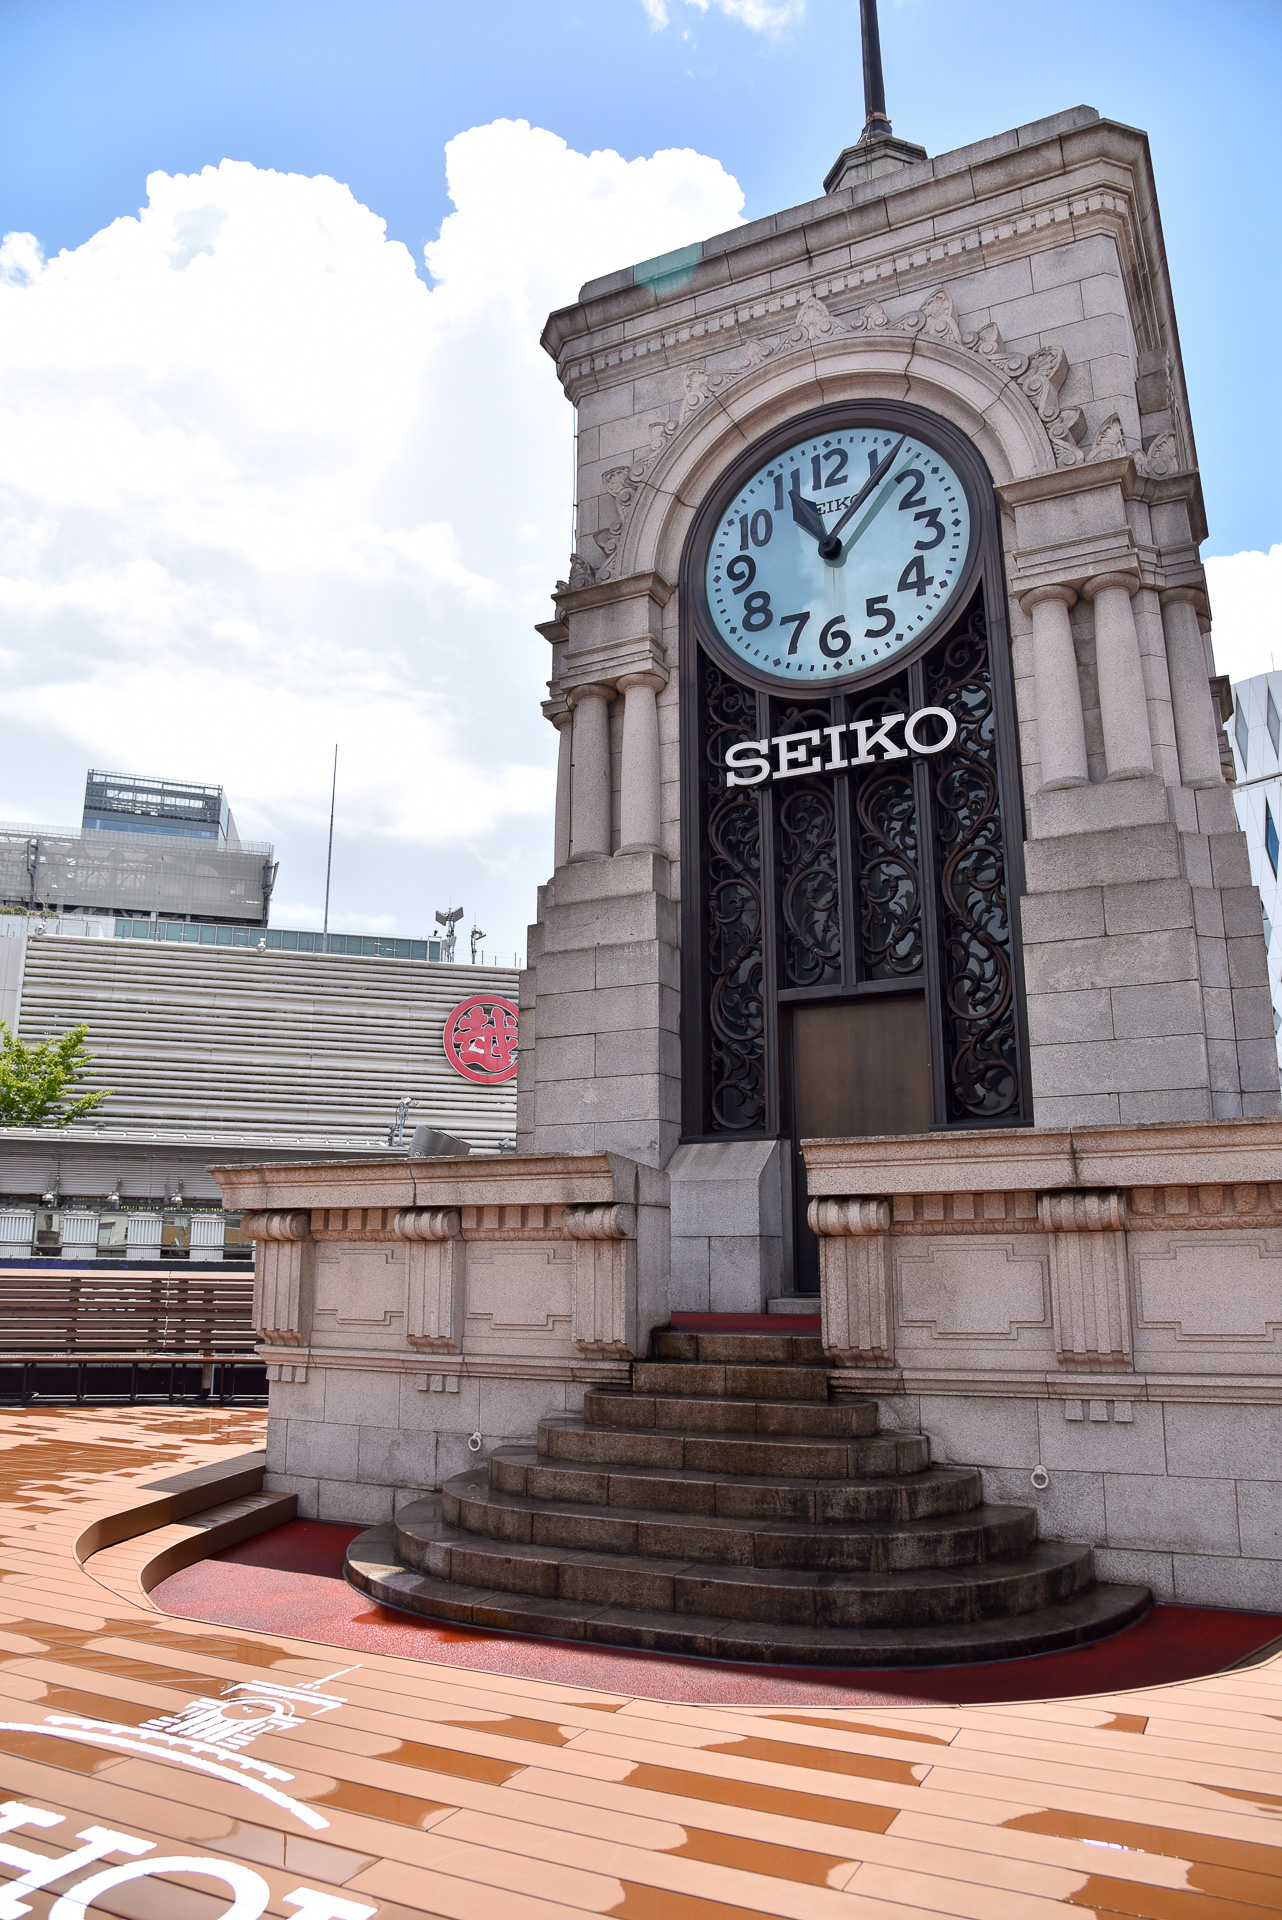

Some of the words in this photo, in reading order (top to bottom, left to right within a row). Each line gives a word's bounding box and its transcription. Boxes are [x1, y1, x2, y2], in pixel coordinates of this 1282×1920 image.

[773, 468, 801, 511] 11
[811, 448, 849, 491] 12
[894, 468, 927, 511] 2
[815, 493, 860, 515] EIK
[739, 508, 773, 551] 10
[913, 507, 946, 550] 3
[726, 554, 756, 595] 9
[897, 555, 934, 597] 4
[742, 591, 773, 632] 8
[779, 611, 810, 655] 7
[864, 595, 895, 638] 5
[819, 614, 851, 658] 6
[725, 706, 957, 787] SEIKO
